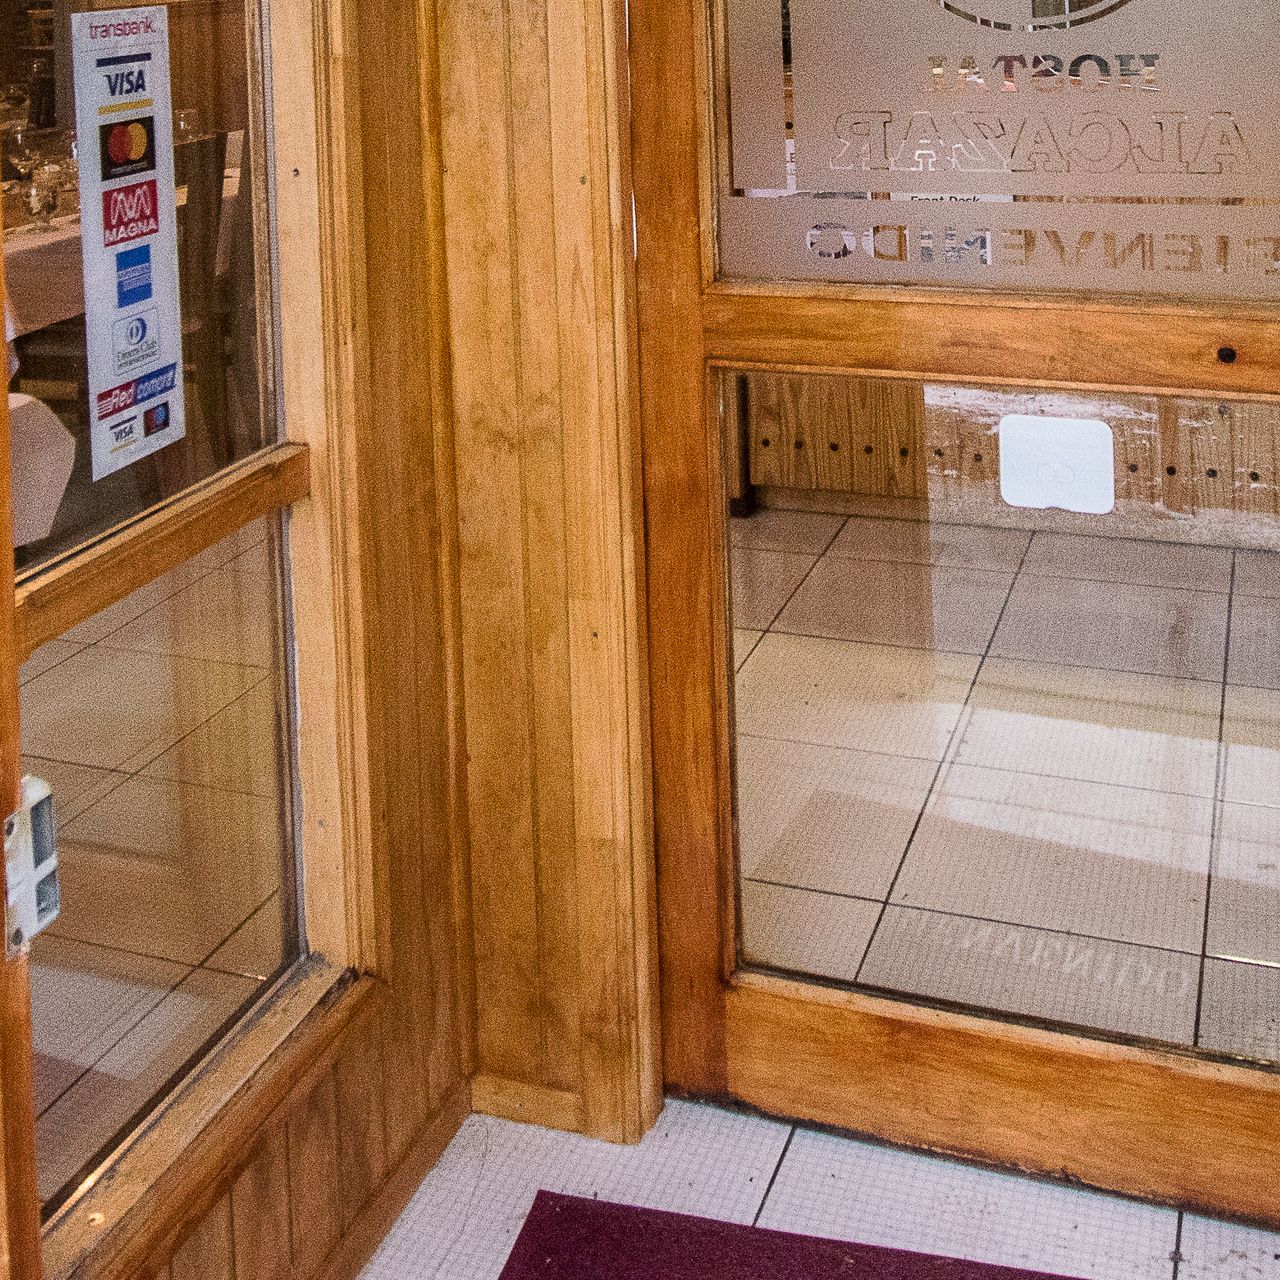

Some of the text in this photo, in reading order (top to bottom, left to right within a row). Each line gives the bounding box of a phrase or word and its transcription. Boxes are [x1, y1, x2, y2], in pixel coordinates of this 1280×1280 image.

[103, 69, 146, 96] VISA
[105, 217, 158, 244] MAGNA
[114, 423, 134, 441] VISA
